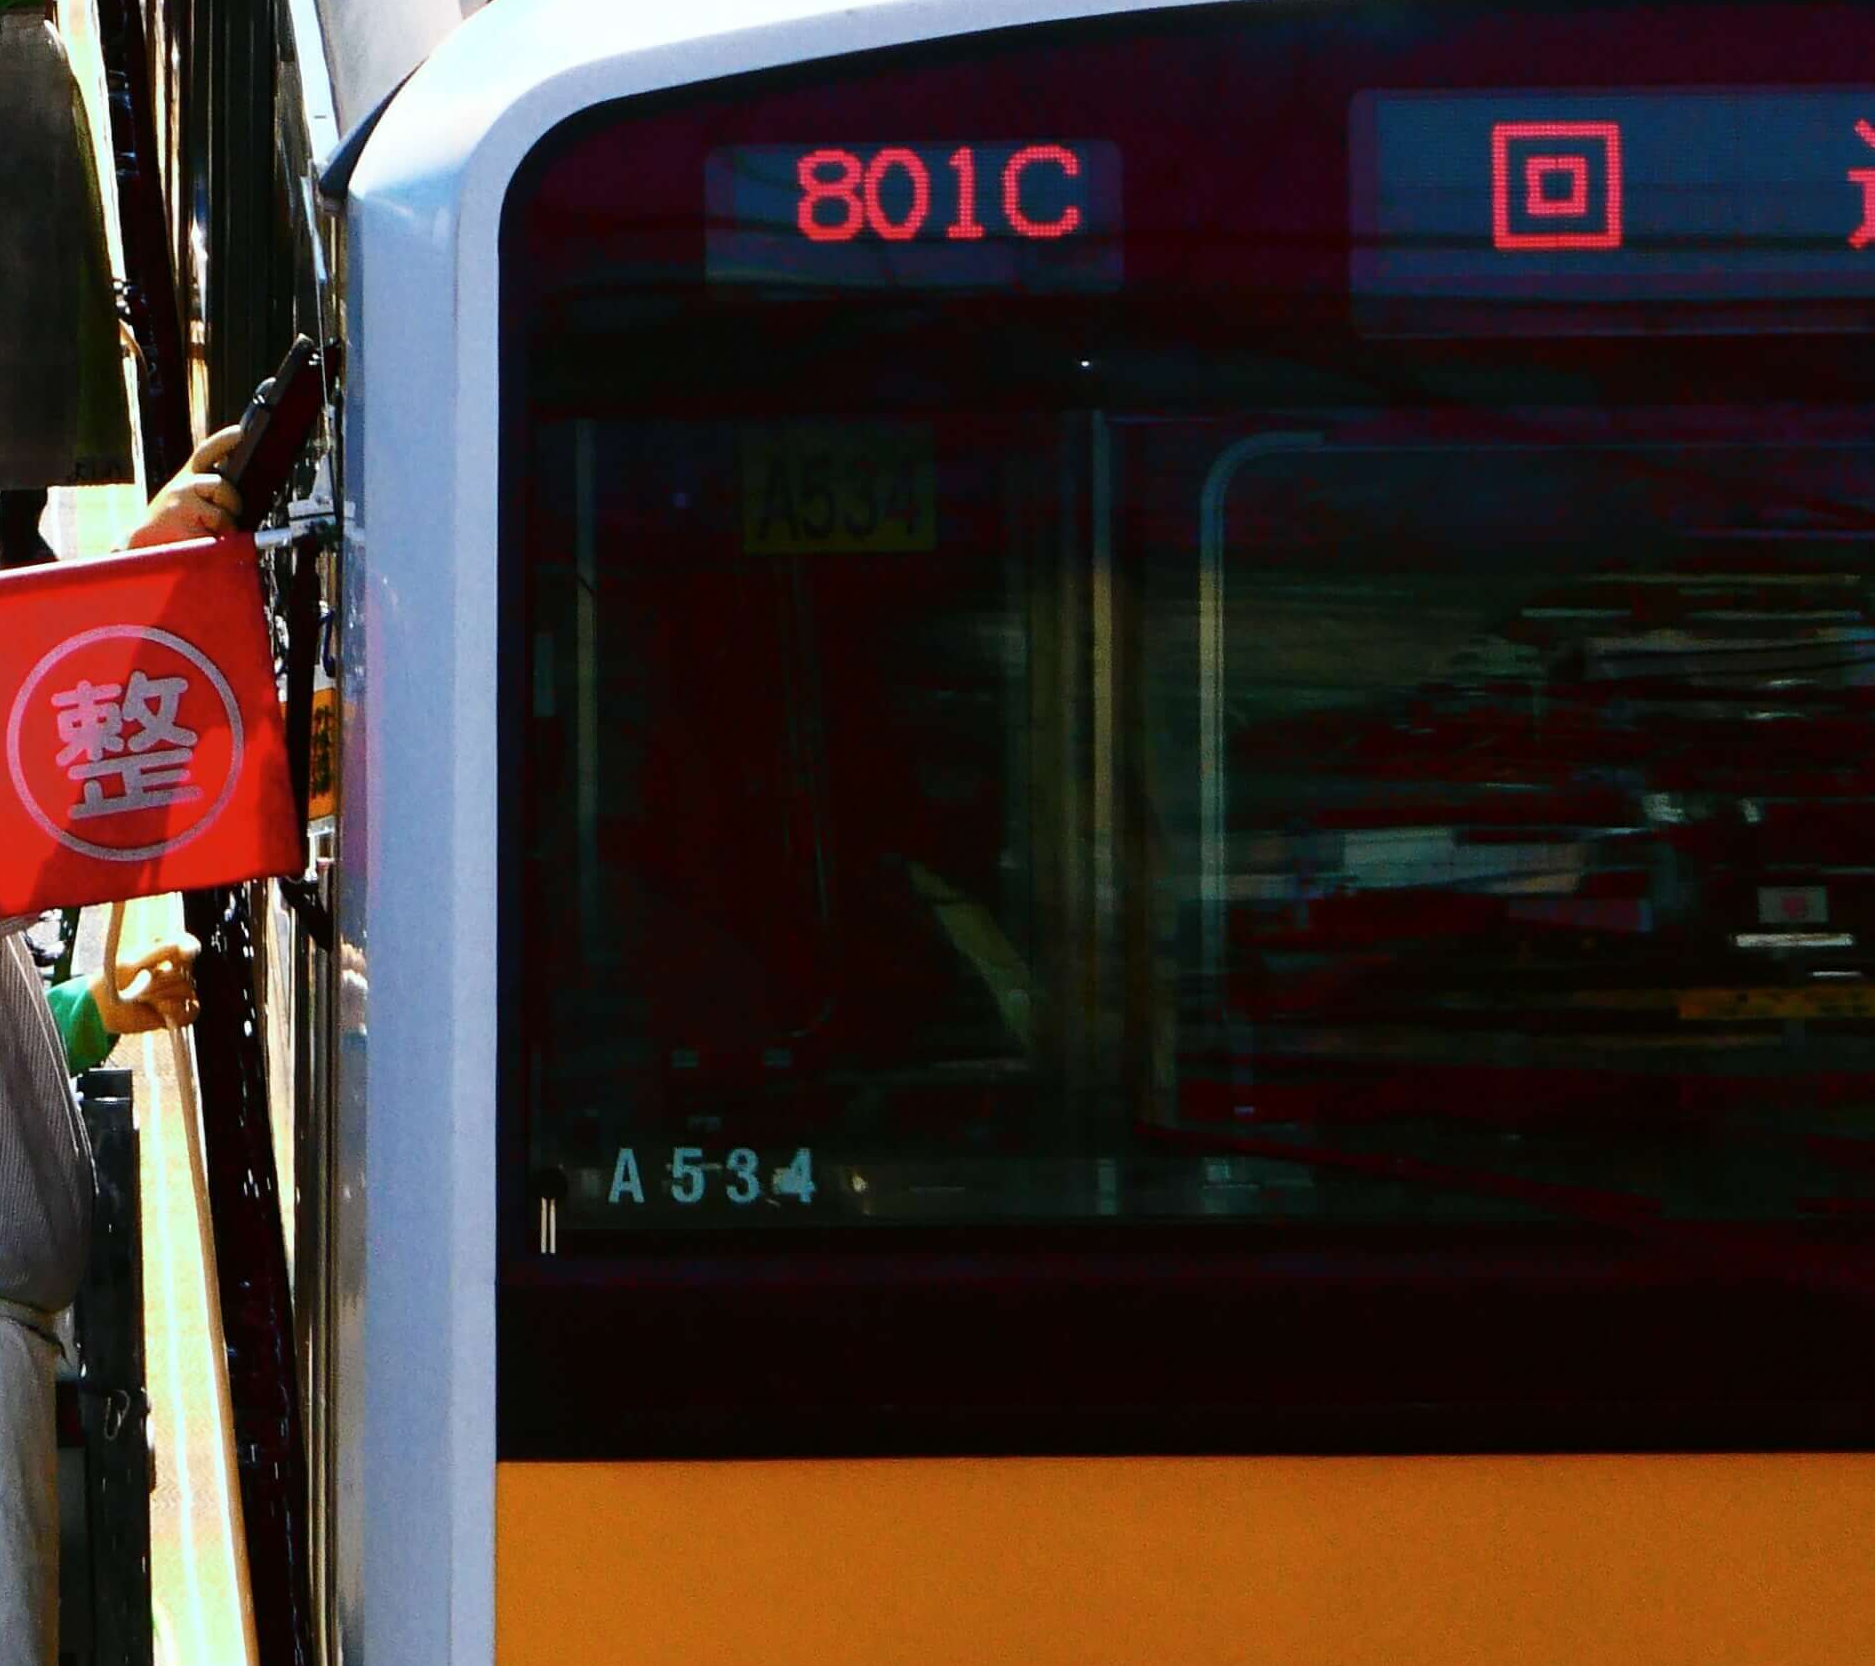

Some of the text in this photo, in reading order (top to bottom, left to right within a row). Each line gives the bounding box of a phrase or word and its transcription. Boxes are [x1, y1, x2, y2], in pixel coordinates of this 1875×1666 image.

[796, 145, 1082, 243] 801C
[1492, 122, 1622, 250] 回
[757, 457, 921, 540] A534
[50, 668, 205, 822] 整
[607, 1146, 817, 1205] A534
